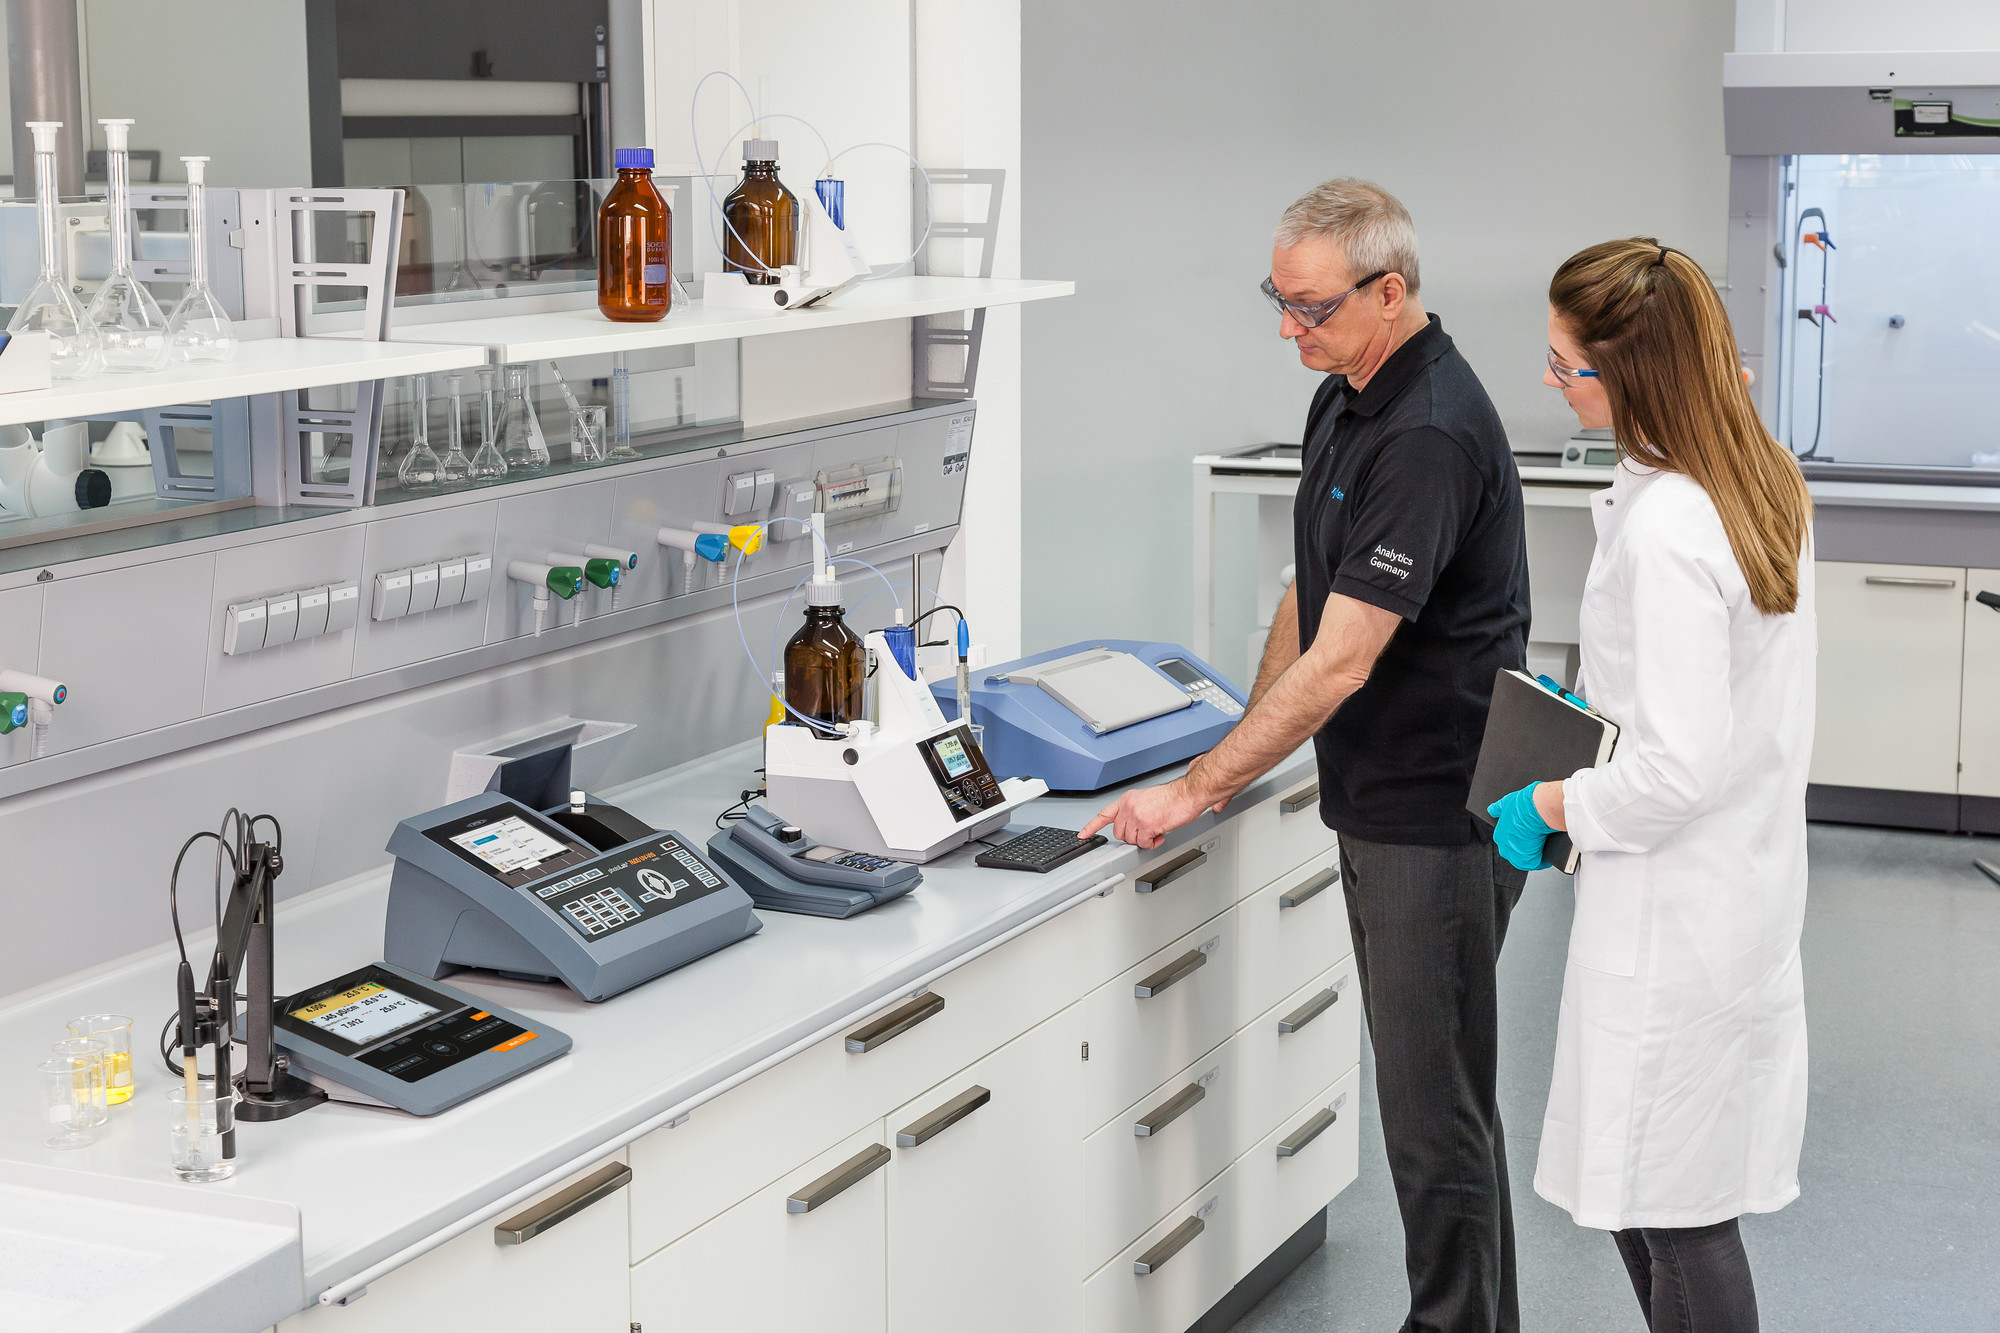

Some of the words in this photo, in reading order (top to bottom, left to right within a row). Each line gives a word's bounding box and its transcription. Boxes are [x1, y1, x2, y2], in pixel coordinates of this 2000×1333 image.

[1374, 544, 1414, 566] Analytics
[1370, 556, 1410, 580] Germany
[320, 1012, 337, 1022] 345
[361, 996, 376, 1006] 25.0
[379, 1003, 394, 1014] 25.0
